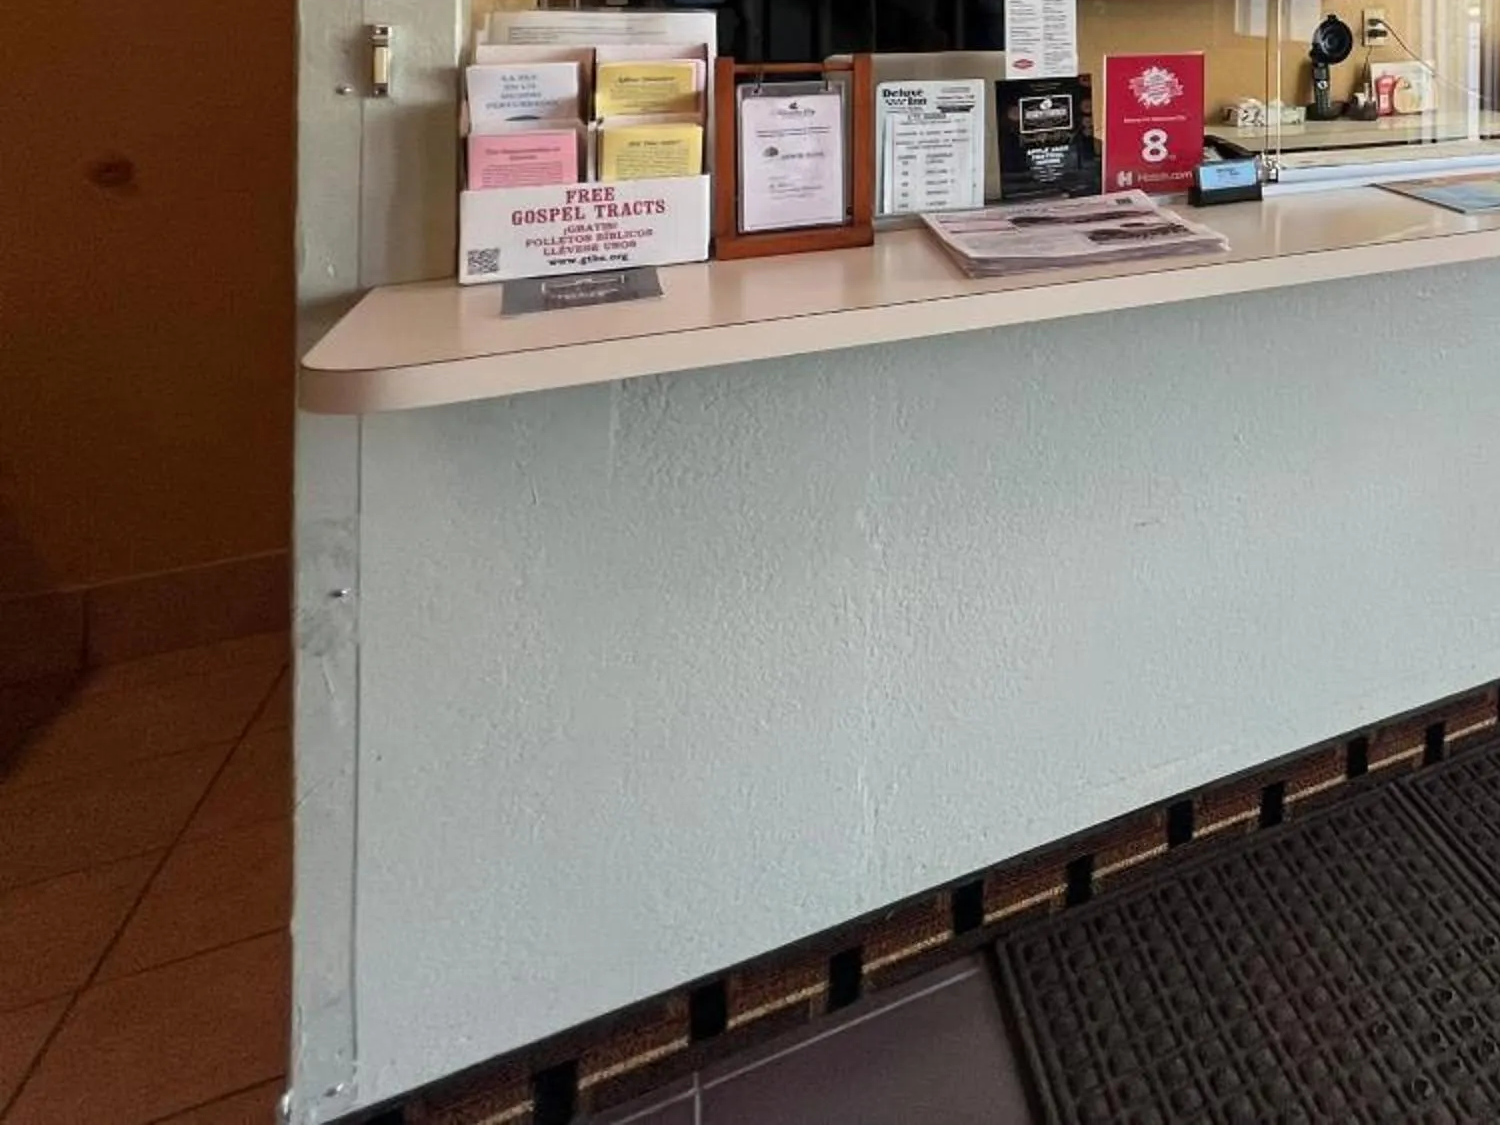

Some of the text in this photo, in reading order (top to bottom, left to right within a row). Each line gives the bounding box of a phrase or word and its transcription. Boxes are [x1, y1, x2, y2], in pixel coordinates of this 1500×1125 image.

[882, 88, 924, 98] Deluxe
[1141, 129, 1168, 162] 8
[566, 187, 615, 204] FREE
[511, 199, 666, 226] GOSPEL TRACTS
[526, 233, 592, 248] FOLLETOS
